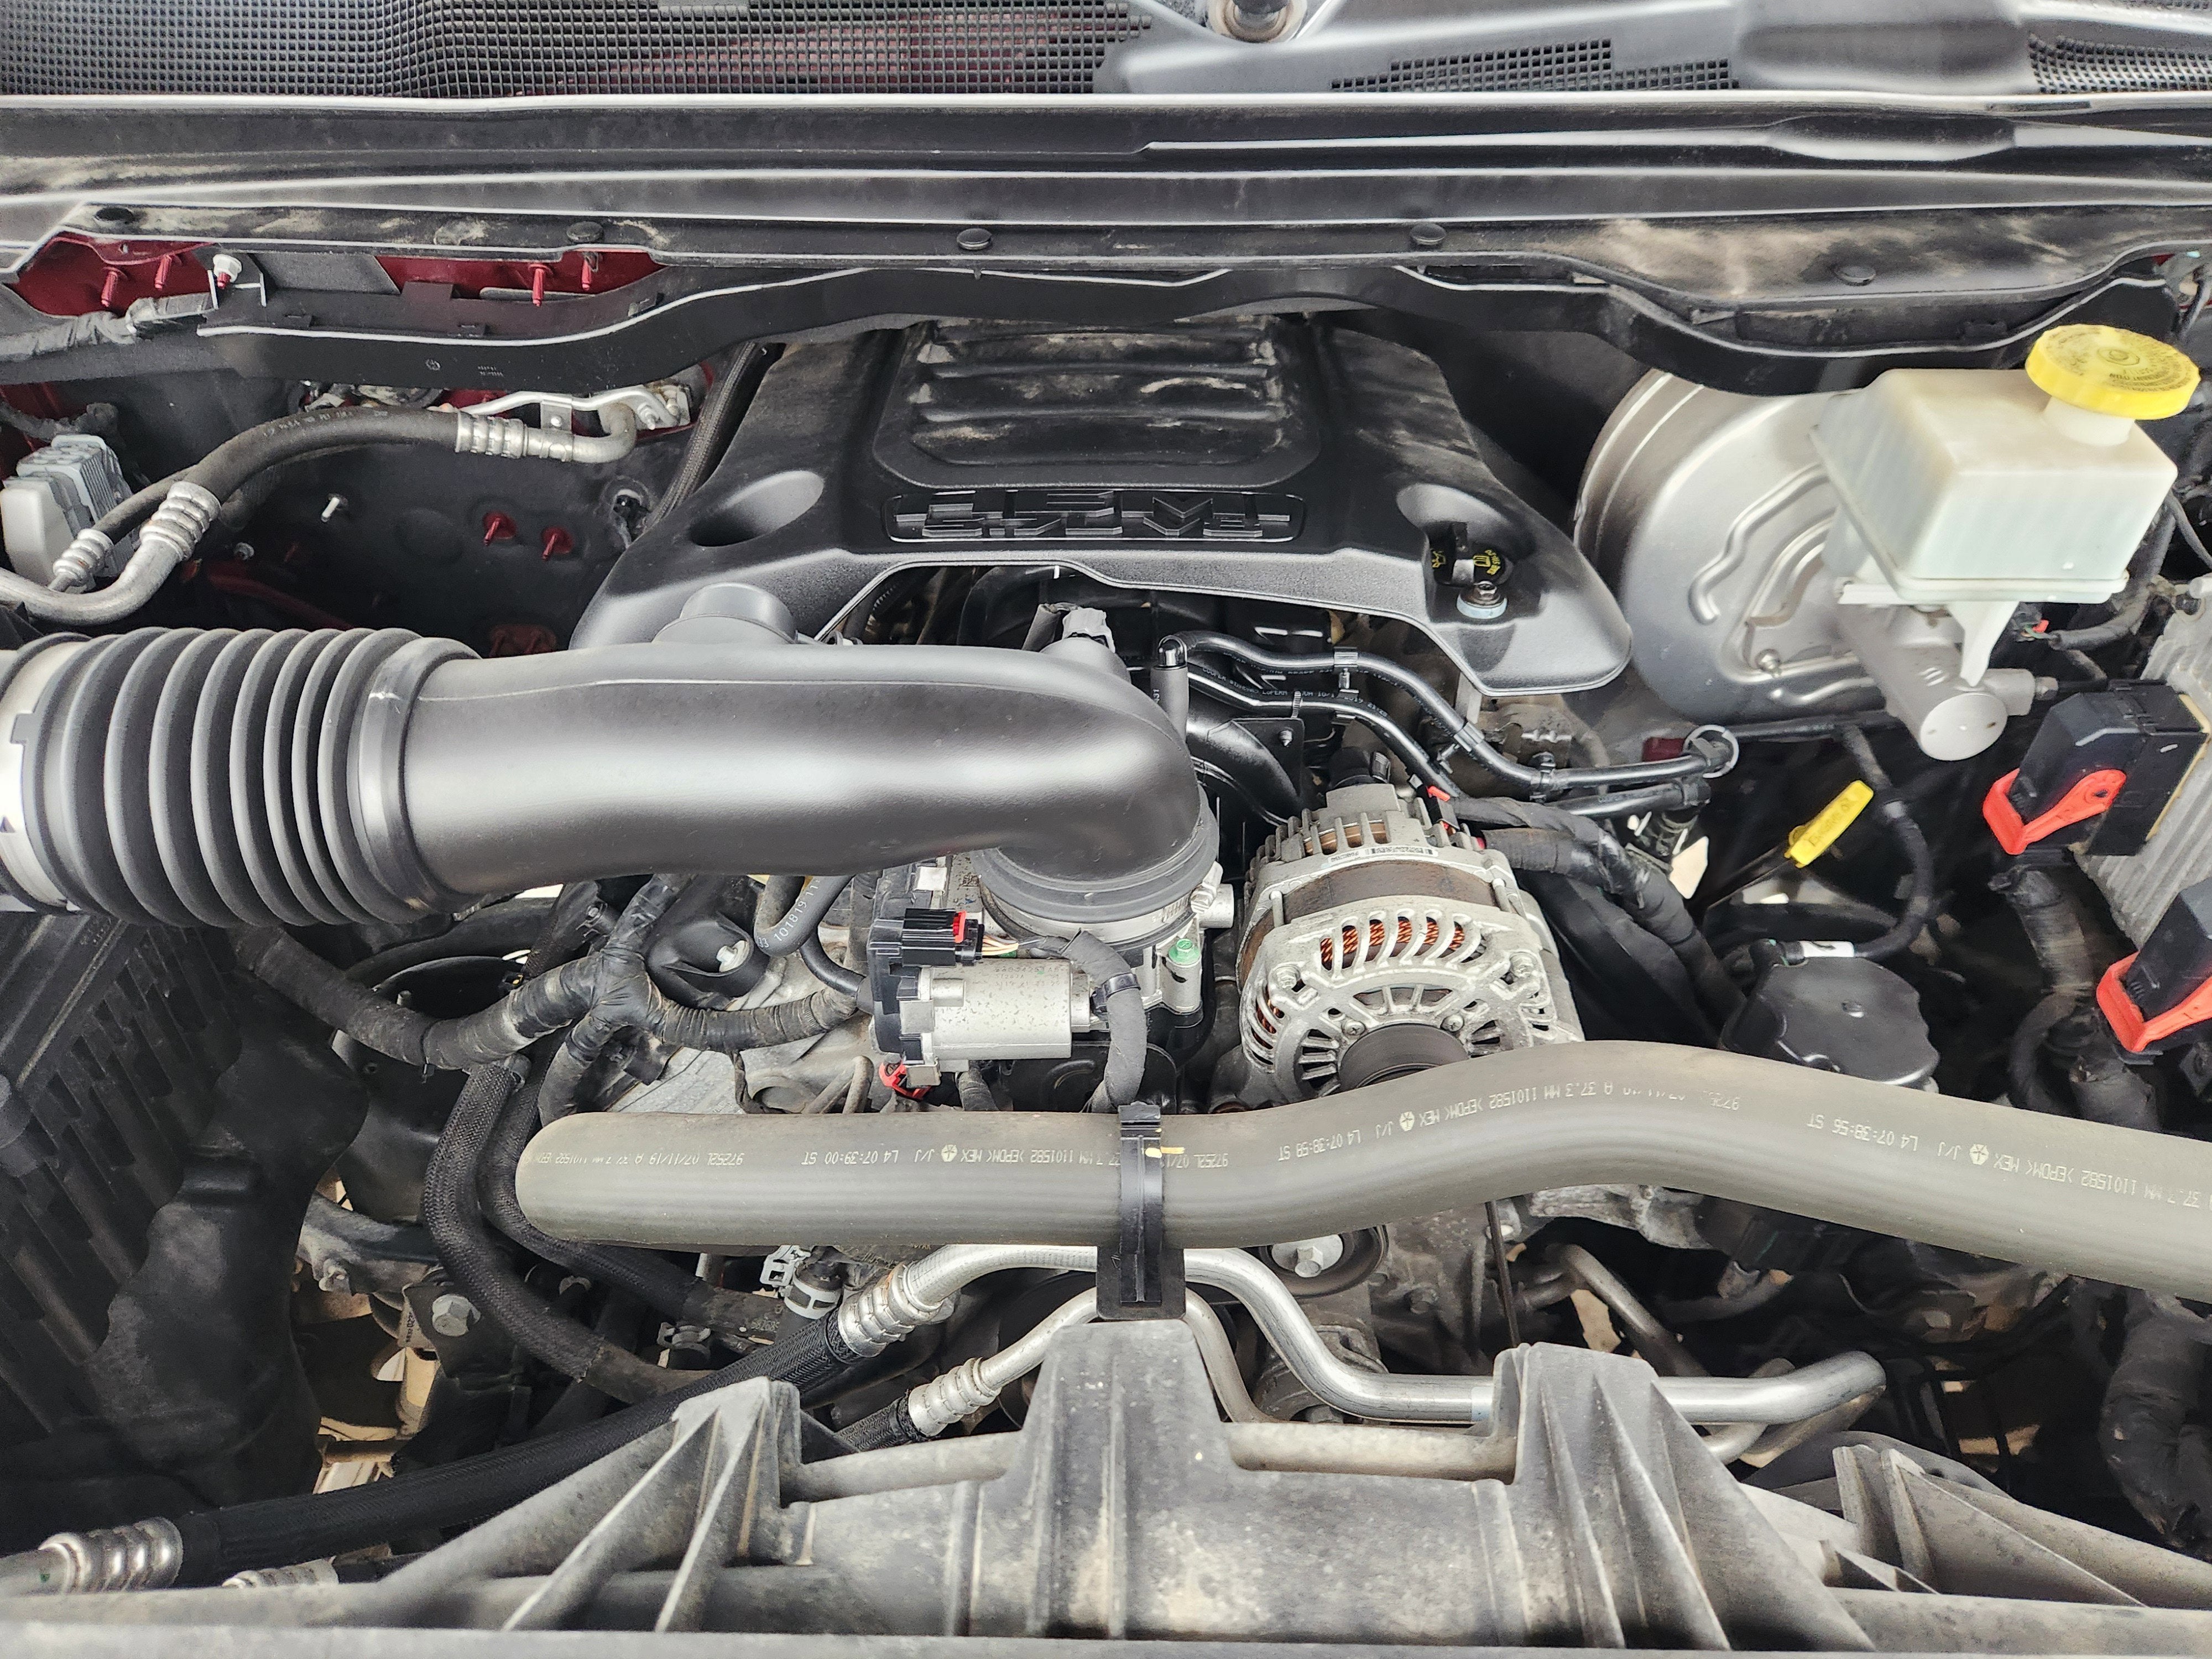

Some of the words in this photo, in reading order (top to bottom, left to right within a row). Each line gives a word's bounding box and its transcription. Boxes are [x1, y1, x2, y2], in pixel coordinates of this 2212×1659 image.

[774, 901, 807, 942] 101819
[1544, 1083, 1561, 1100] MM
[1564, 1081, 1597, 1097] 37.3
[1603, 1081, 1613, 1095] A
[1489, 1086, 1537, 1109] 1101582
[1418, 1109, 1440, 1128] MEX
[1806, 1113, 1825, 1129] ST
[1346, 1129, 1361, 1146] L4
[1900, 1133, 1918, 1152] L4
[649, 1152, 700, 1165] 07/11/19
[801, 1151, 818, 1165] ST
[824, 1150, 879, 1165] 07:39:00
[883, 1150, 899, 1163] L4
[961, 1149, 983, 1163] MEX
[1031, 1150, 1074, 1164] 1101582
[1277, 1145, 1291, 1162] ST
[1993, 1153, 2020, 1173] MEX
[2080, 1170, 2137, 1196] 1101582
